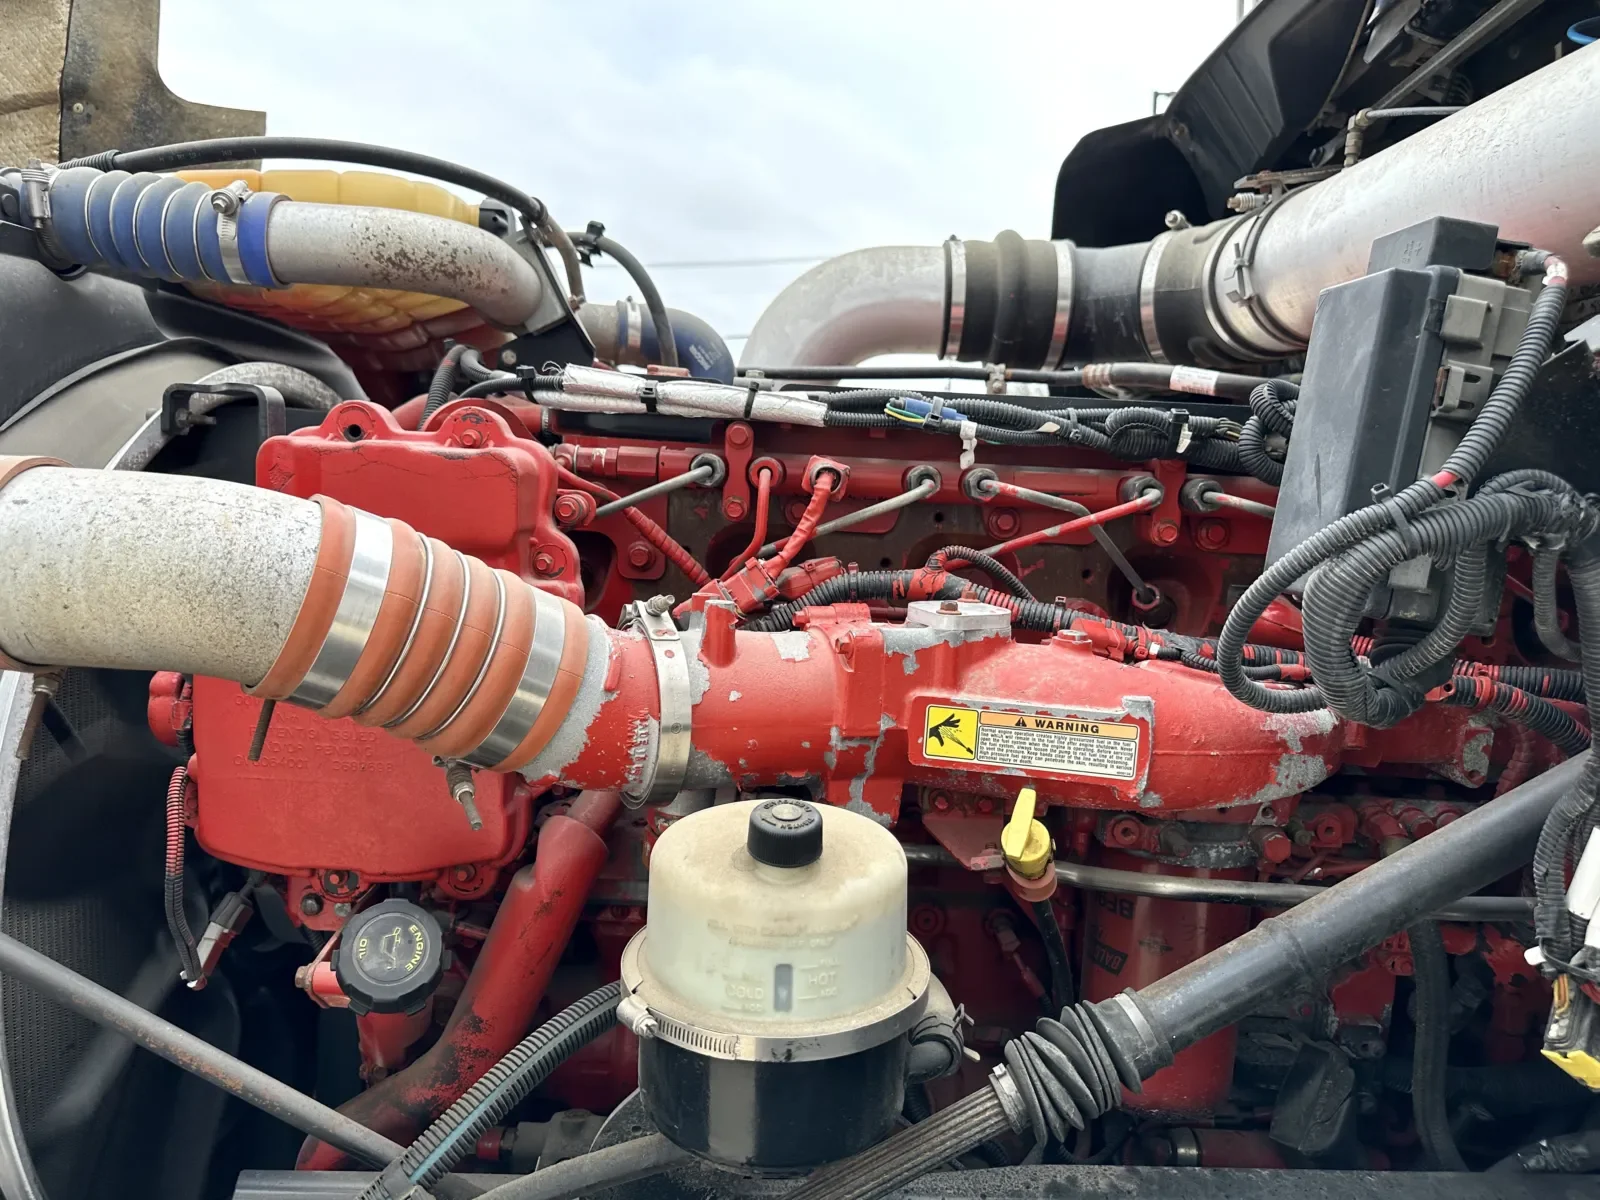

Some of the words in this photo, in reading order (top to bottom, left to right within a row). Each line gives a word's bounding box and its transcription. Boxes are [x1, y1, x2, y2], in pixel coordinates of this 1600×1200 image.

[1035, 719, 1099, 734] WARNING
[358, 939, 368, 959] OIL
[405, 925, 424, 971] ENGINE
[808, 971, 837, 985] HOT
[726, 983, 764, 1000] COLD
